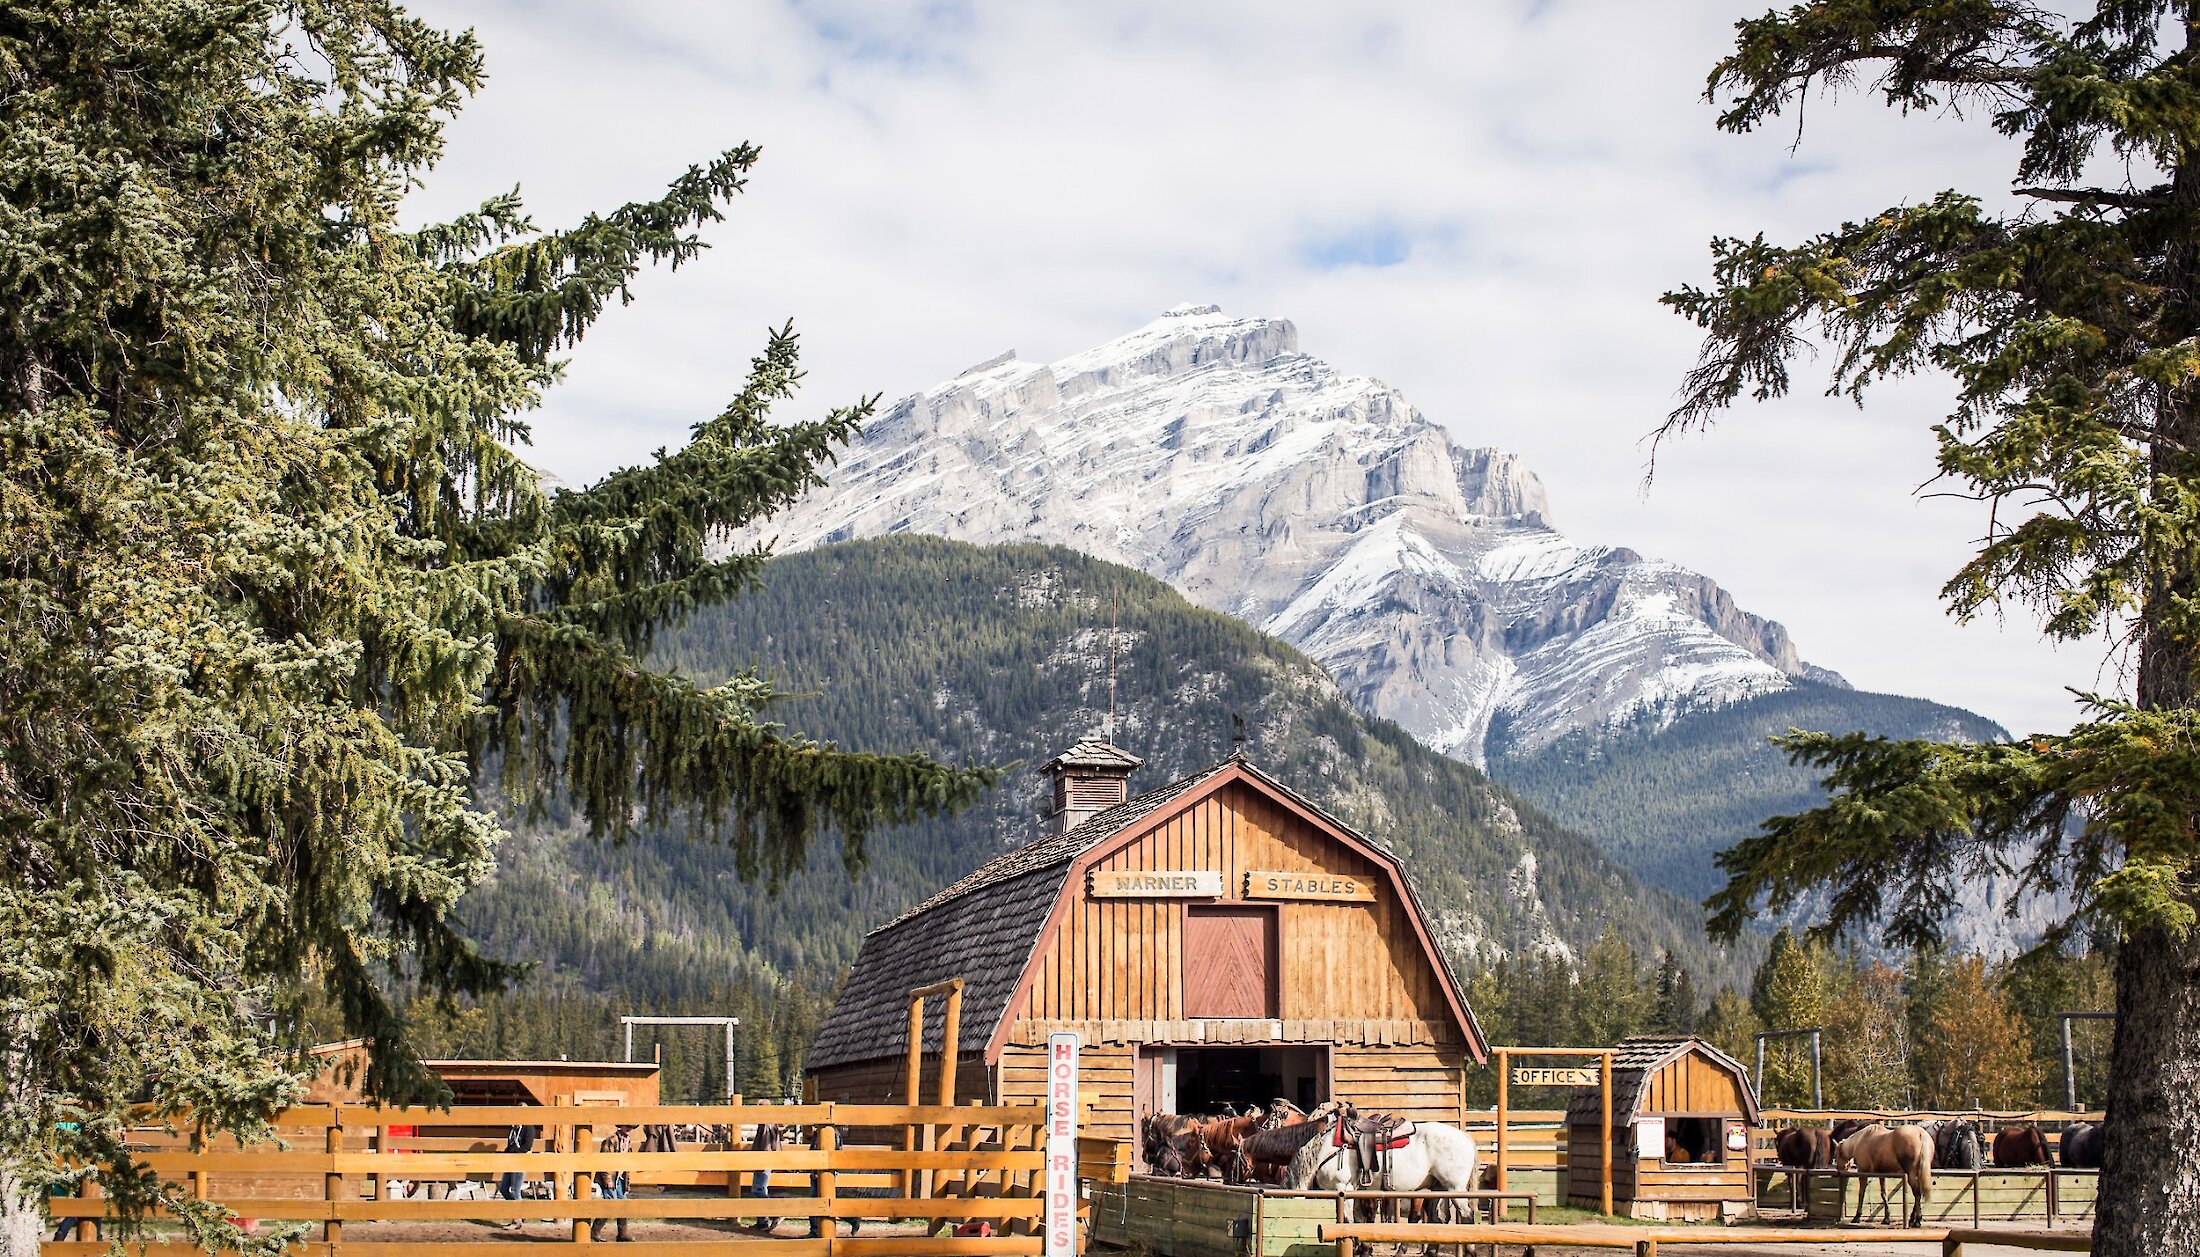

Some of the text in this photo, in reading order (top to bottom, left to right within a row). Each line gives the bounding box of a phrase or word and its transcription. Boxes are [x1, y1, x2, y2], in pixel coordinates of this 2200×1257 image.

[1116, 877, 1198, 891] WARNER
[1267, 879, 1355, 894] STABLES
[1521, 1070, 1576, 1083] OFFICE
[1053, 1044, 1071, 1247] HORSE RIDES
